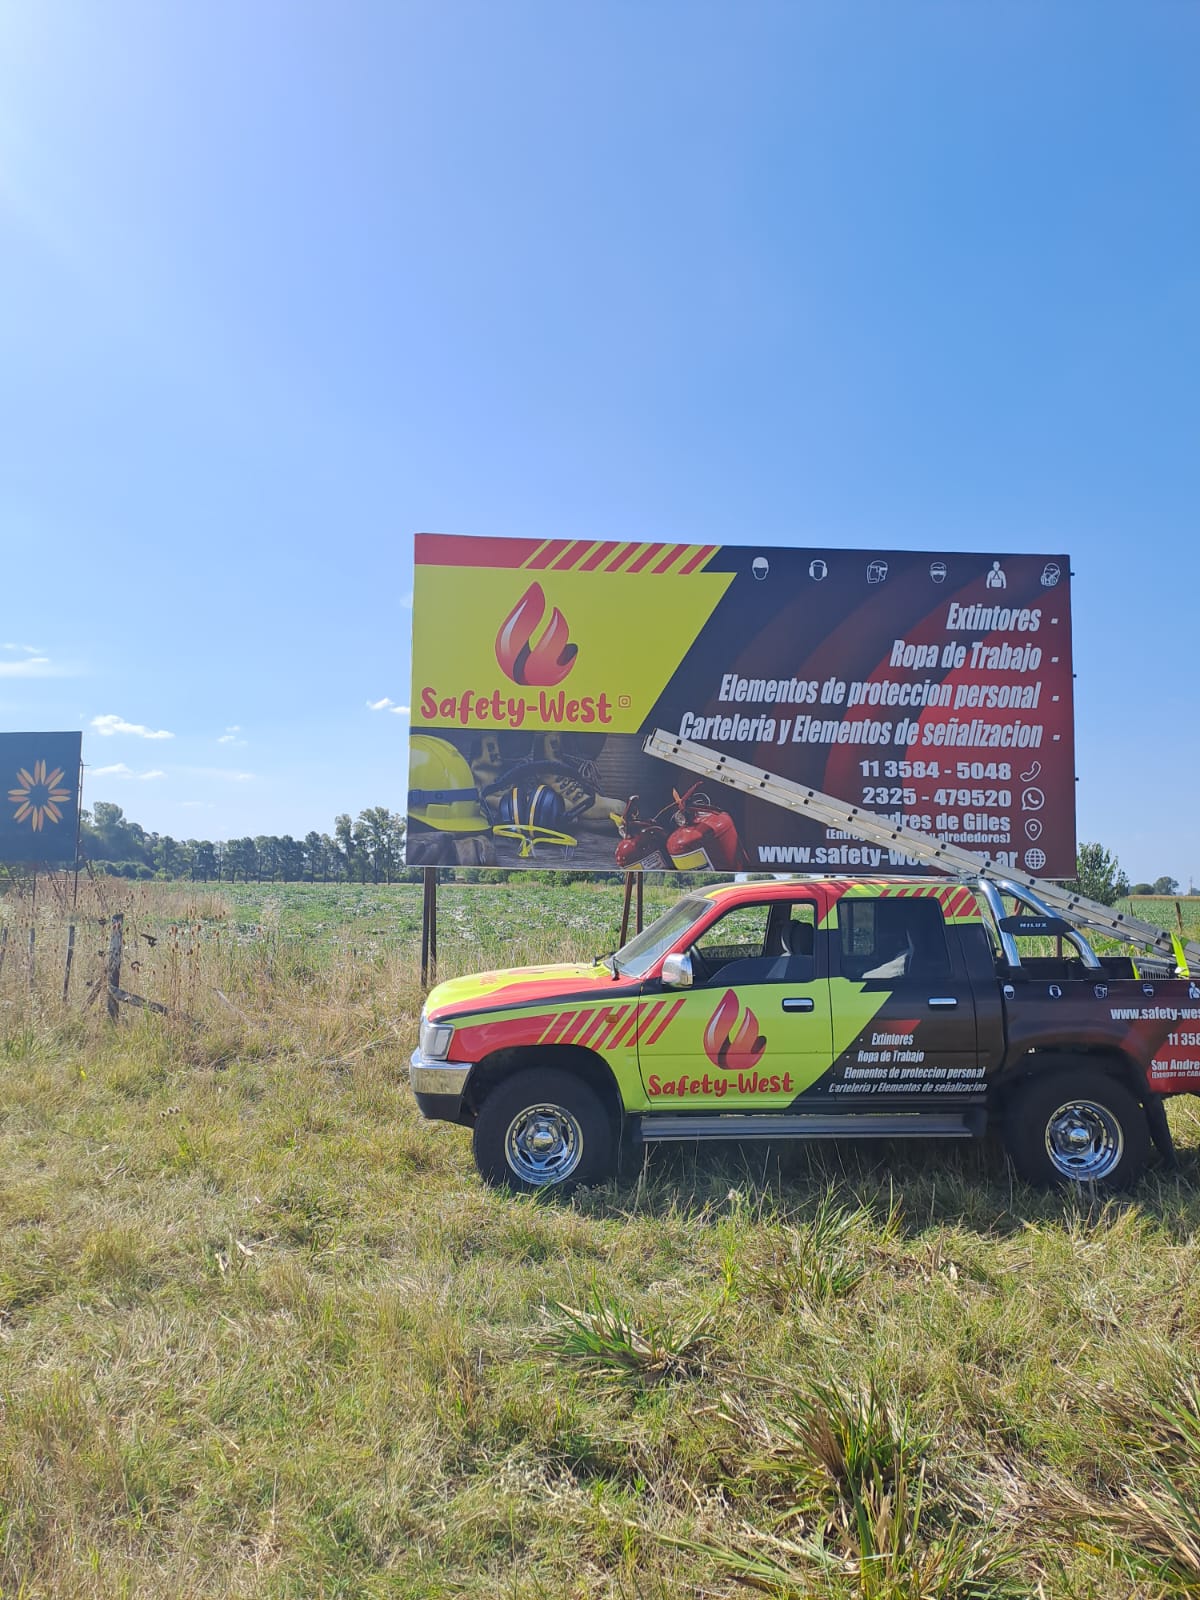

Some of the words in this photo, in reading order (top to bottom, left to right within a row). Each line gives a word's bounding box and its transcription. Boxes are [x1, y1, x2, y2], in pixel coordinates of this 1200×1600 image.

[946, 602, 1042, 632] Extintores
[889, 639, 939, 670] Ropa
[941, 641, 966, 669] de
[970, 641, 1042, 673] Trabajo
[718, 673, 818, 704] Elementos
[820, 676, 846, 705] de
[847, 679, 953, 708] proteccion
[953, 681, 1042, 710] personal
[420, 686, 613, 727] Safety-West
[678, 711, 777, 742] Carteleria
[777, 719, 792, 745] y
[792, 714, 892, 745] Elementos
[894, 717, 919, 746] de
[921, 717, 1043, 748] señalizacion
[859, 760, 879, 777] 11
[885, 760, 940, 778] 3584
[956, 762, 1012, 780] 5048
[862, 787, 916, 805] 2325
[933, 789, 1012, 807] 479520
[935, 812, 959, 831] de
[963, 813, 1011, 832] Giles
[871, 1032, 914, 1046] Extintores
[1168, 1033, 1179, 1046] 11
[857, 1050, 879, 1064] Ropa
[880, 1050, 891, 1062] de
[893, 1050, 925, 1063] Trabajo
[1151, 1059, 1168, 1071] San
[1170, 1059, 1200, 1071] Andre
[843, 1066, 888, 1079] Elementos
[888, 1067, 900, 1079] de
[900, 1067, 946, 1080] proteccion
[946, 1066, 985, 1080] personal
[648, 1071, 795, 1098] Safety-West
[870, 1084, 877, 1093] y
[877, 1082, 921, 1092] Elementos
[921, 1083, 934, 1092] de
